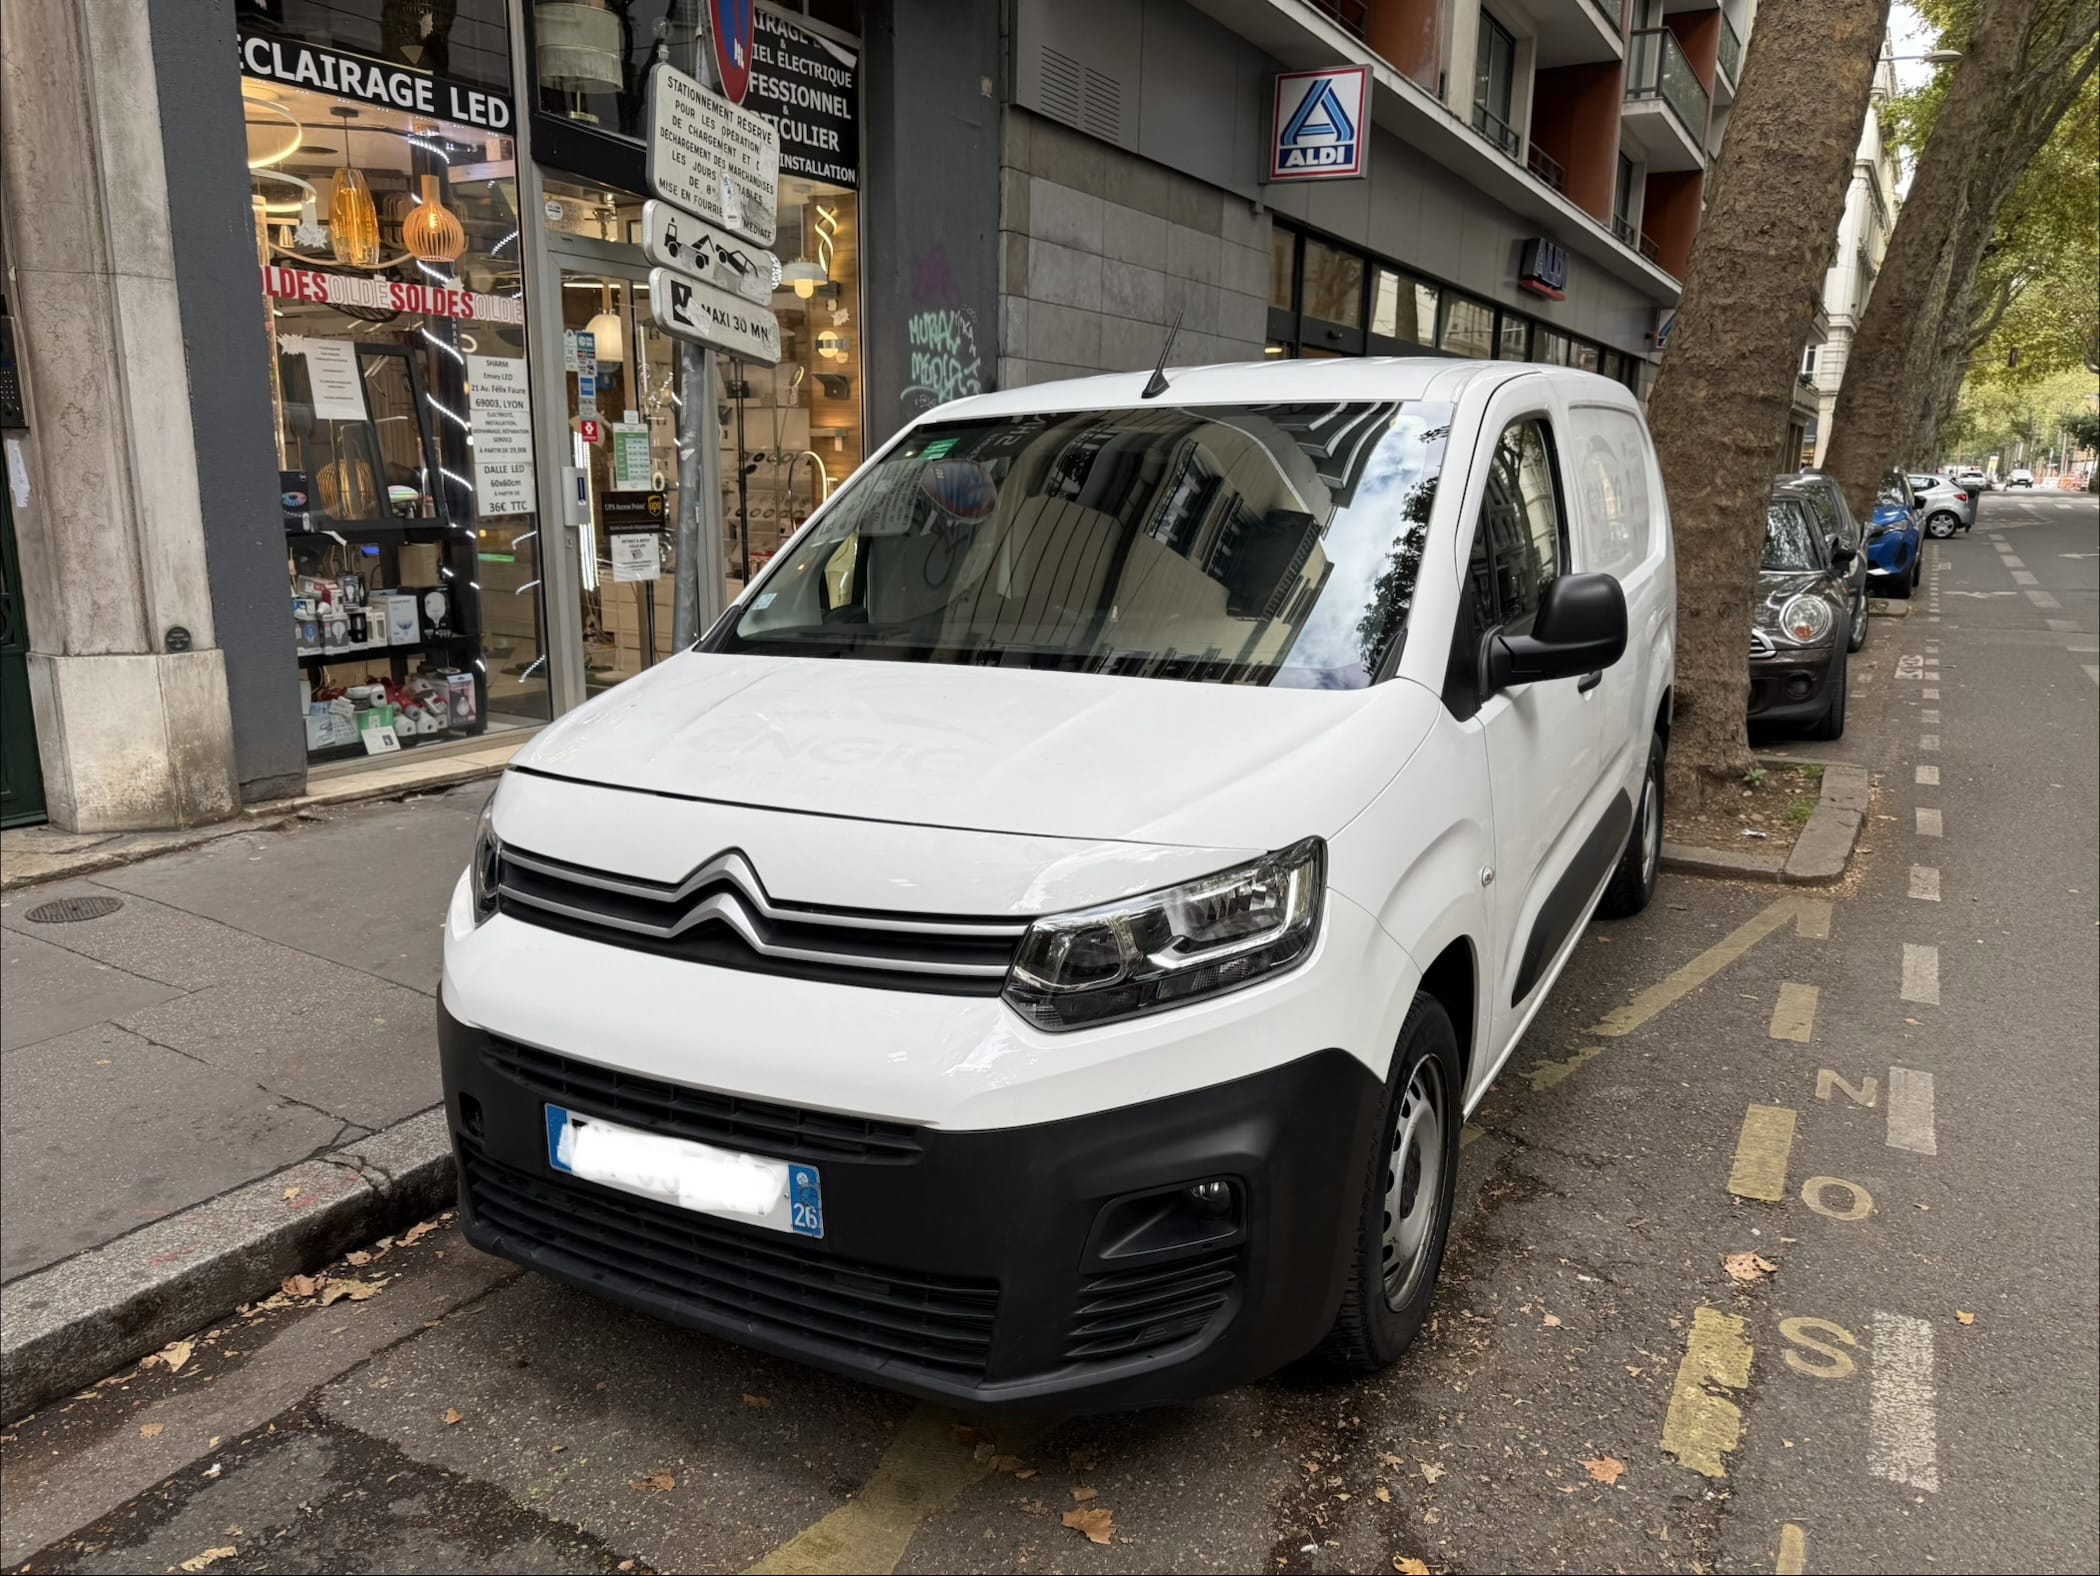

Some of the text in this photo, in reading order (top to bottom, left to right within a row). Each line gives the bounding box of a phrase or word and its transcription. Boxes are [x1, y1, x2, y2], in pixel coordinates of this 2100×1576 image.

[237, 34, 510, 129] CLAIRAGE LED
[777, 50, 853, 89] ELECTRIQUE
[667, 75, 734, 122] STATIONNEMENT
[749, 71, 852, 120] FESSIONNEL
[675, 99, 696, 119] POUR
[701, 114, 716, 130] LES
[672, 115, 682, 129] DE
[688, 124, 737, 158] CHARGEMENT
[742, 152, 751, 166] ET
[671, 149, 687, 166] LES
[692, 164, 717, 181] JOURS
[713, 154, 726, 169] DES
[780, 152, 856, 184] INSTALLATION
[1285, 146, 1345, 167] ALDI
[659, 177, 678, 196] MISE
[681, 188, 691, 202] EN
[689, 175, 700, 189] DE
[259, 264, 329, 303] LDES
[390, 281, 475, 320] SOLDES
[733, 315, 747, 334] 30
[751, 322, 768, 343] MN
[471, 384, 479, 392] 21
[508, 386, 526, 394] Faure
[501, 373, 513, 381] LED
[475, 399, 524, 409] 69003, LYON
[484, 465, 525, 474] DALLE LED
[489, 501, 528, 513] 36€ TTC
[793, 1202, 818, 1230] 26
